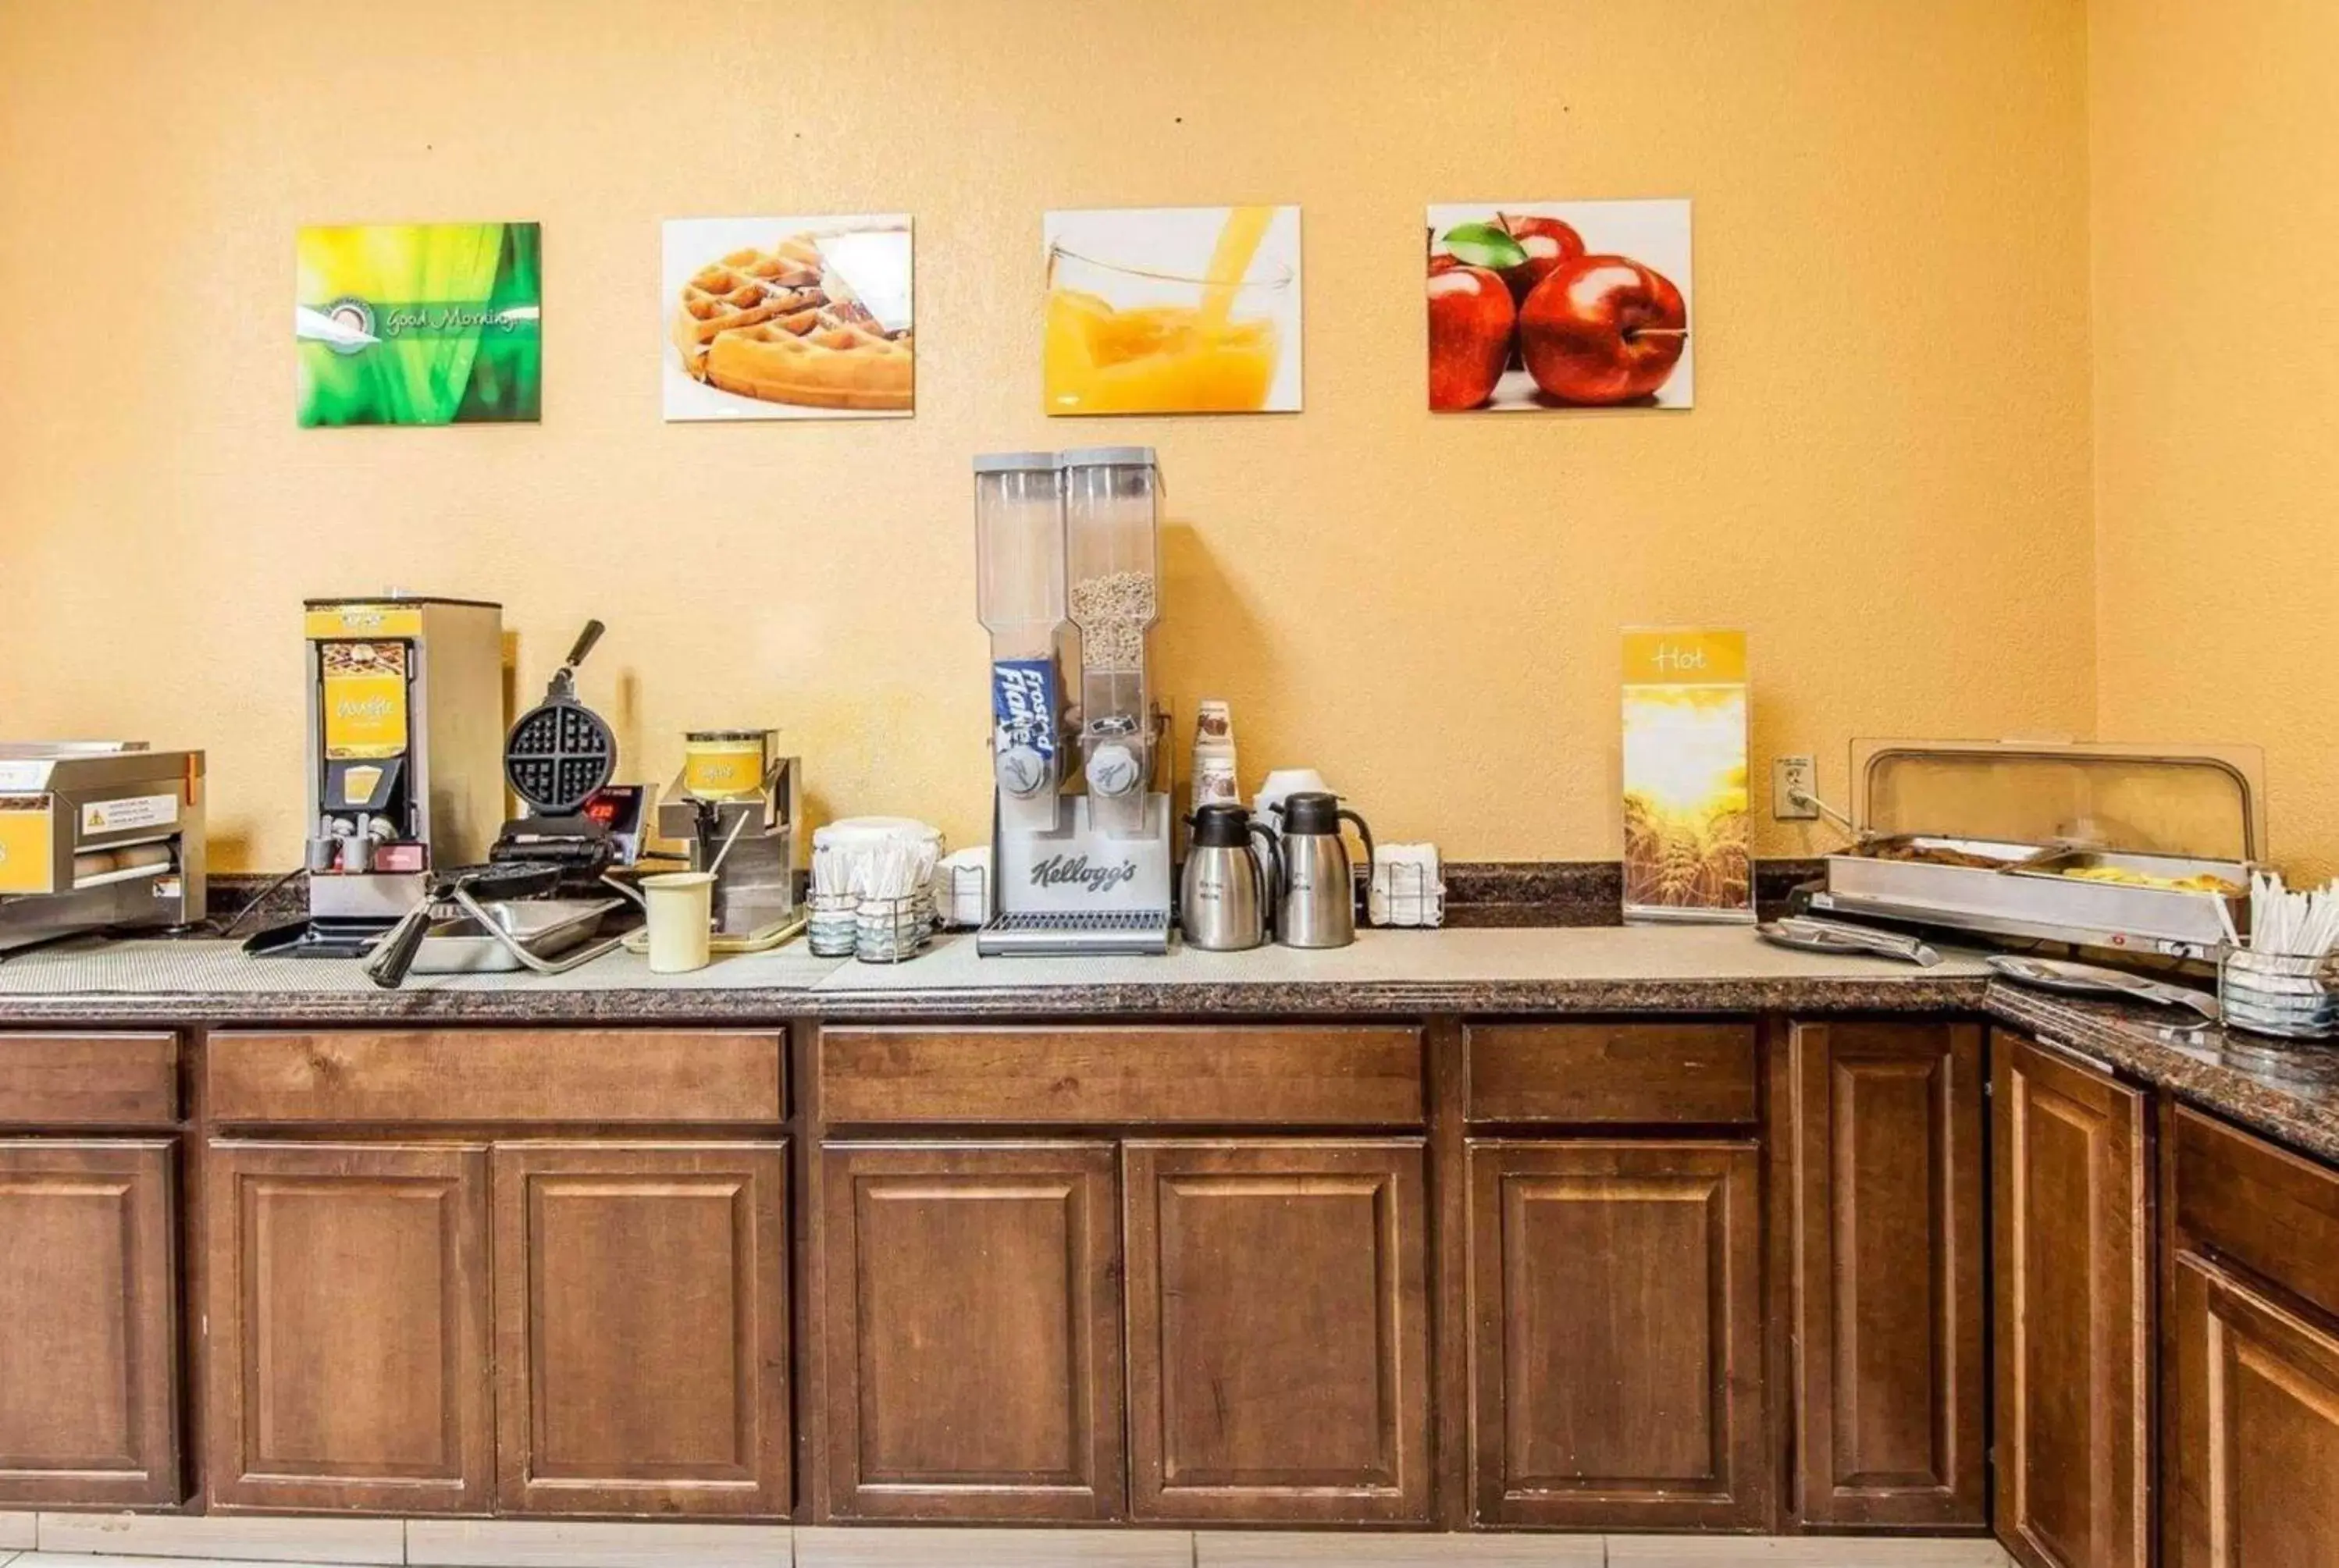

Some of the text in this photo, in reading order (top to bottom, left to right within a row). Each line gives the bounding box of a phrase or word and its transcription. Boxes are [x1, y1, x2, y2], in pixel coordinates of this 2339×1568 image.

[386, 308, 428, 337] Good
[430, 305, 518, 334] Morning
[1650, 642, 1707, 674] Hot
[995, 667, 1034, 745] Flake
[1030, 853, 1137, 892] Kellogg's
